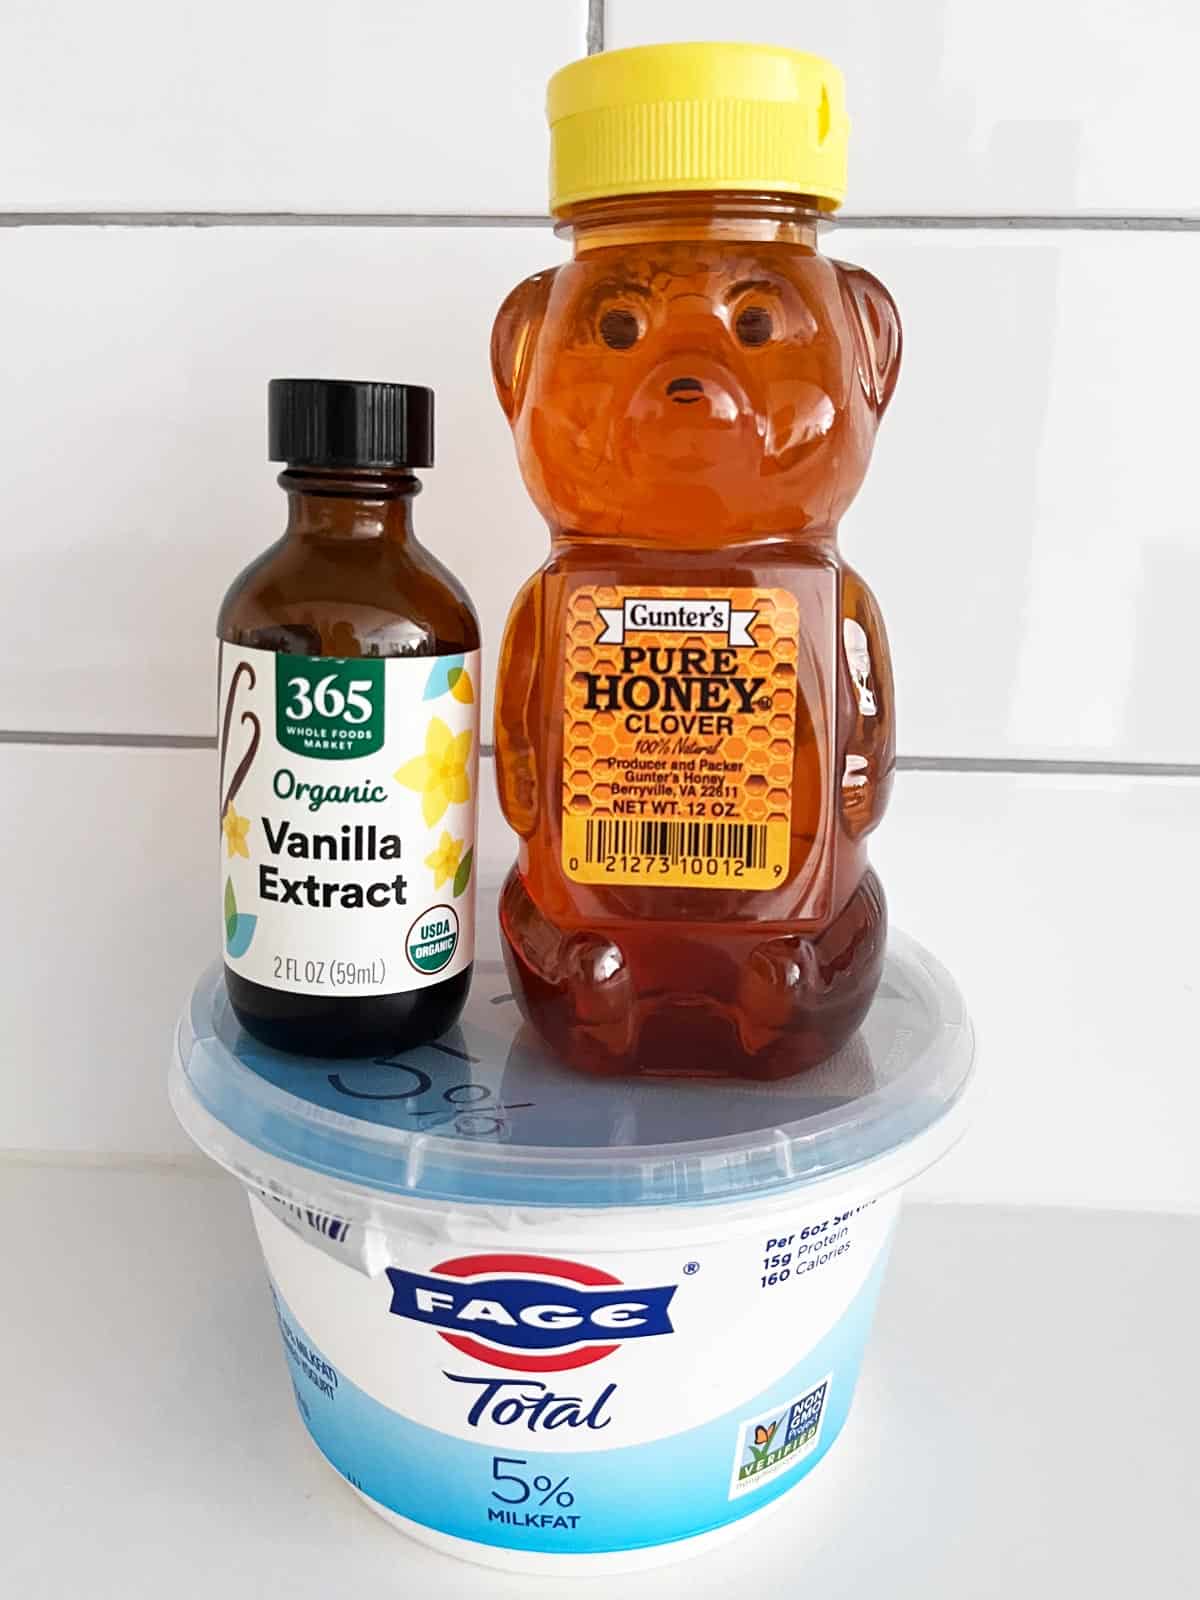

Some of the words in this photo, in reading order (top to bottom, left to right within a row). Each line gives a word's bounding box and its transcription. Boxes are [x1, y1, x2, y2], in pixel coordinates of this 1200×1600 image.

[629, 603, 724, 628] Gunter's
[620, 646, 738, 676] PURE
[285, 674, 373, 724] 365
[583, 673, 766, 714] HONEY
[286, 726, 328, 738] WHOLE
[331, 729, 373, 740] FOODS
[624, 714, 733, 736] CLOVER
[303, 738, 353, 751] MARKET
[633, 738, 670, 755] 100%
[672, 735, 724, 755] Natural
[607, 757, 667, 770] Producer
[671, 759, 695, 771] and
[699, 760, 744, 772] Packer
[624, 770, 680, 784] Gunter's
[684, 772, 726, 787] Honey
[272, 768, 388, 812] Organic
[610, 783, 677, 799] Berryville,
[679, 785, 697, 797] VA
[612, 799, 647, 815] NET
[650, 800, 682, 816] WT.
[687, 801, 706, 816] 12
[711, 802, 740, 817] OZ.
[261, 817, 402, 861] Vanilla
[569, 858, 579, 871] 0
[605, 855, 670, 874] 21273
[679, 858, 744, 877] 10012
[773, 865, 783, 878] 9
[258, 865, 408, 909] Extract
[420, 918, 450, 940] USDA
[415, 937, 455, 959] ORGANIC
[273, 955, 283, 979] 2
[286, 959, 301, 980] FL
[304, 961, 326, 984] OZ
[329, 962, 386, 986] (59mL)
[763, 1253, 792, 1270] 15g
[797, 1226, 849, 1259] Protein
[765, 1234, 795, 1253] Per
[800, 1220, 829, 1240] 6oz
[760, 1268, 791, 1289] 160
[795, 1240, 851, 1275] Calories
[415, 1287, 649, 1330] FAGE
[441, 1369, 618, 1432] Total
[789, 1401, 821, 1429] GMO
[792, 1386, 825, 1418] NON
[744, 1427, 816, 1475] VERIFIED
[491, 1456, 575, 1508] 5%
[487, 1507, 581, 1530] MILKFAT
